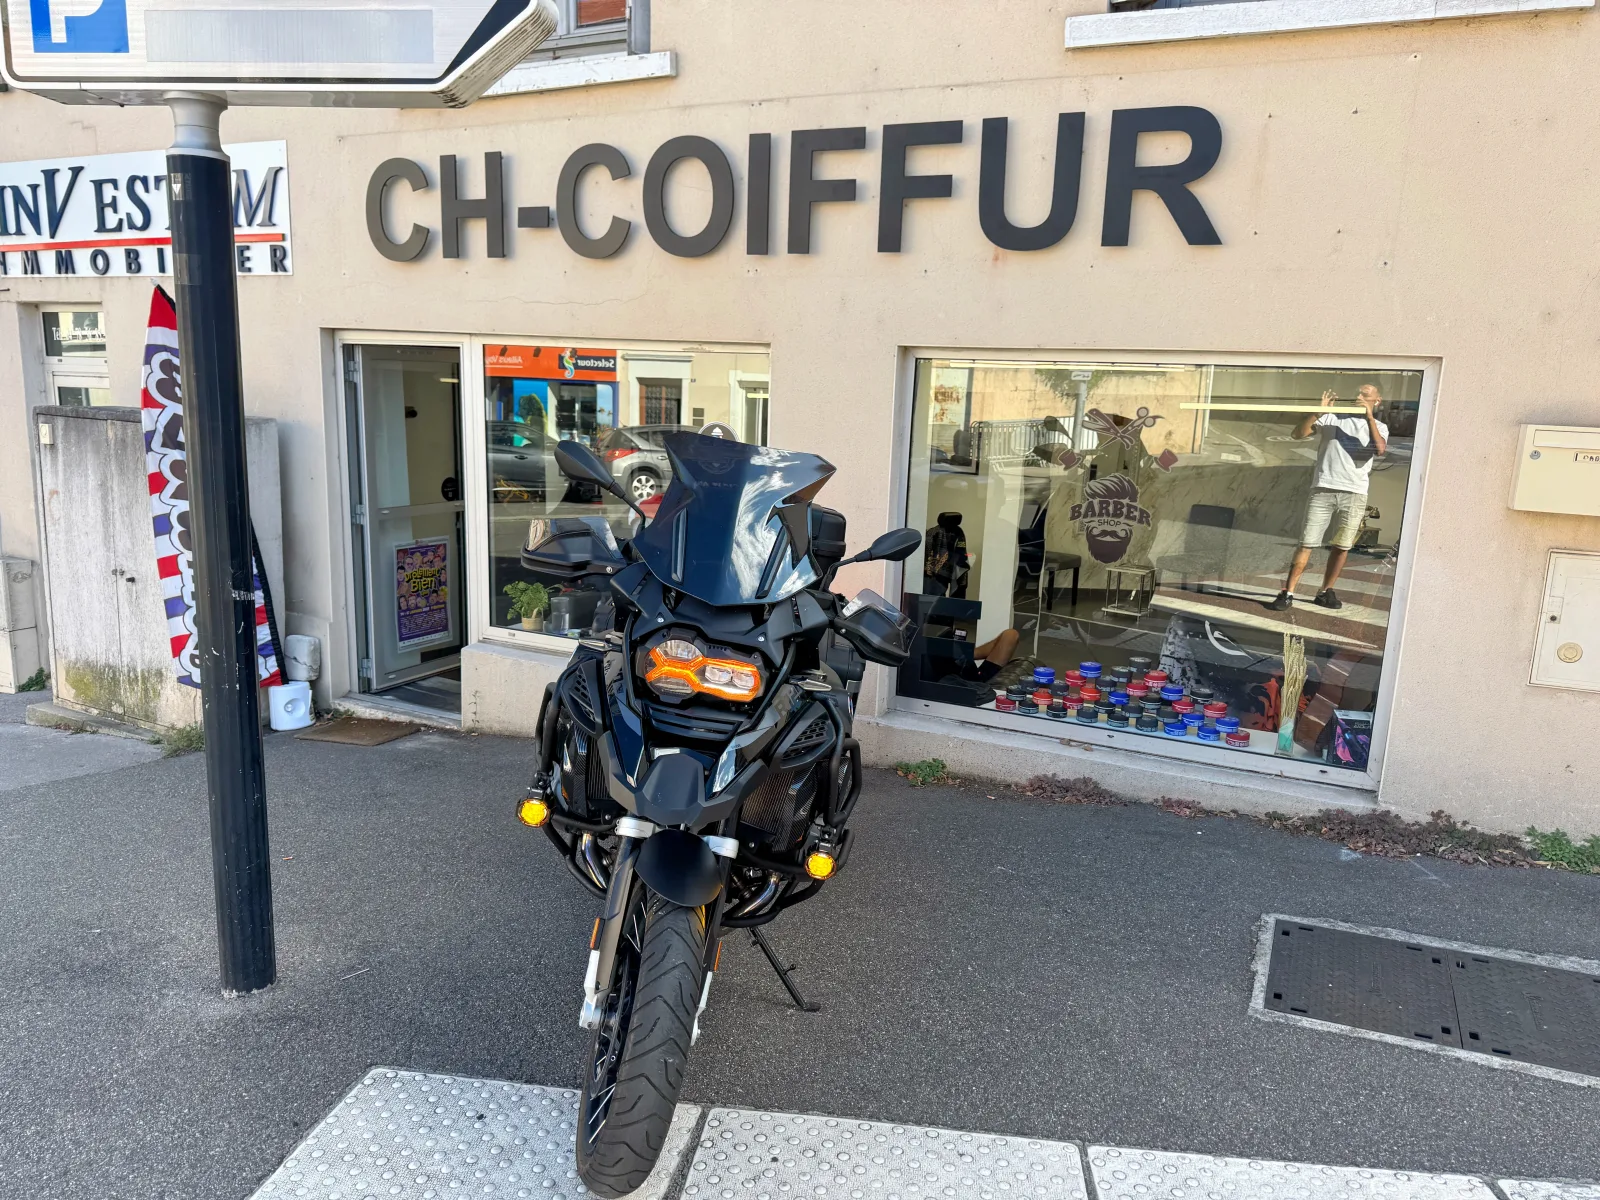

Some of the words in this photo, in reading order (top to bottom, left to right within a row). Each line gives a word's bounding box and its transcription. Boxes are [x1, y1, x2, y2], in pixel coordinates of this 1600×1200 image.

[366, 105, 1223, 262] CH-COIFFUR
[1069, 499, 1152, 530] BARBER
[1097, 519, 1122, 528] SHOP
